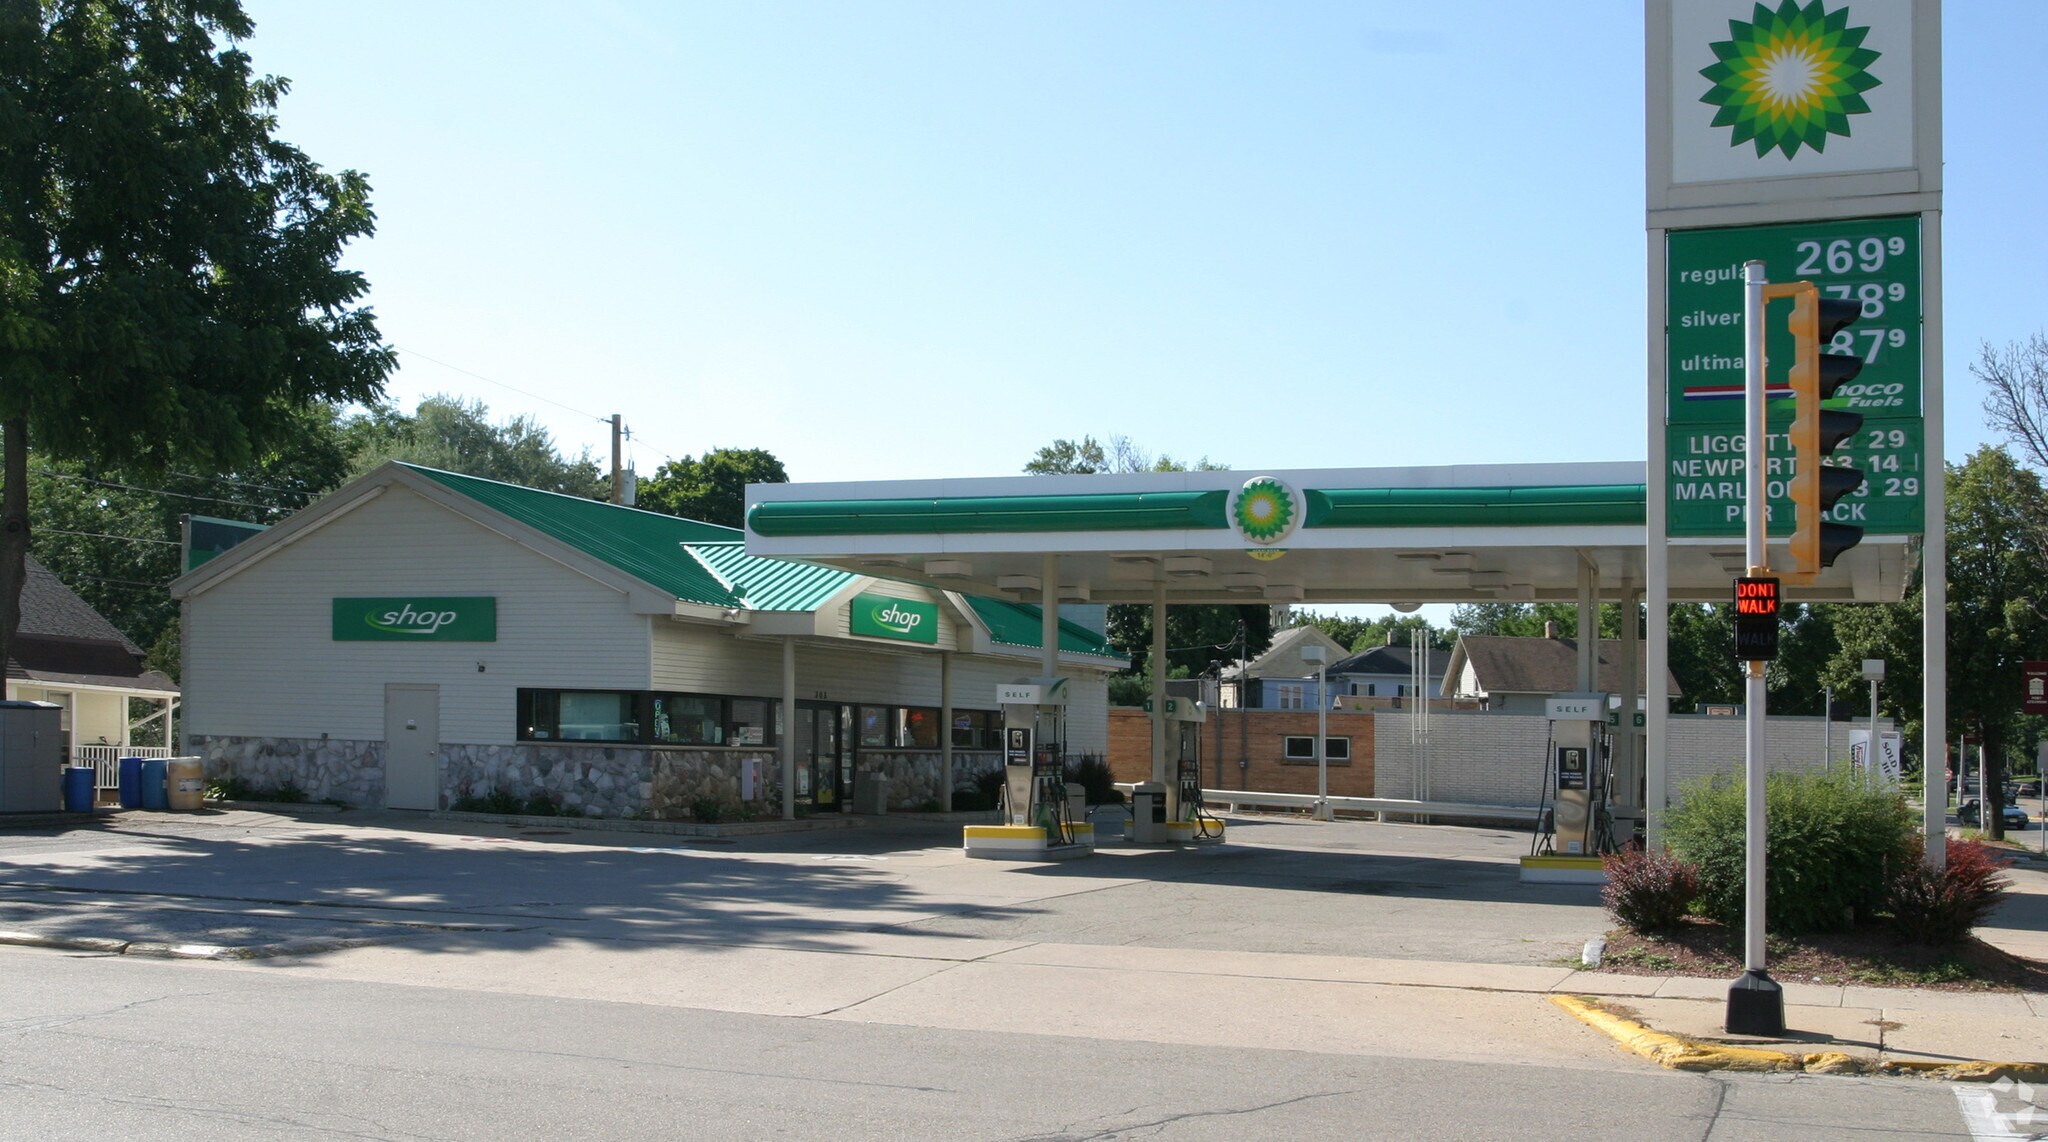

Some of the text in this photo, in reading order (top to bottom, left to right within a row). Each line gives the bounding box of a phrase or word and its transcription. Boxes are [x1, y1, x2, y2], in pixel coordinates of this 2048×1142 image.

[1681, 264, 1746, 285] regula
[1681, 310, 1741, 327] silver
[1848, 396, 1904, 408] Fuels
[1690, 433, 1793, 454] LIGGTT
[1868, 430, 1905, 449] 29
[1672, 457, 1797, 477] NEWPRT
[1868, 454, 1899, 473] 14
[1884, 478, 1919, 497] 29
[1738, 583, 1775, 597] DONT
[1738, 600, 1775, 613] WALK
[383, 603, 457, 634] shop
[880, 603, 921, 633] shop
[1167, 702, 1174, 711] 2
[1556, 705, 1589, 713] SELF
[1636, 715, 1642, 724] 6
[1882, 741, 1898, 768] SOLD
